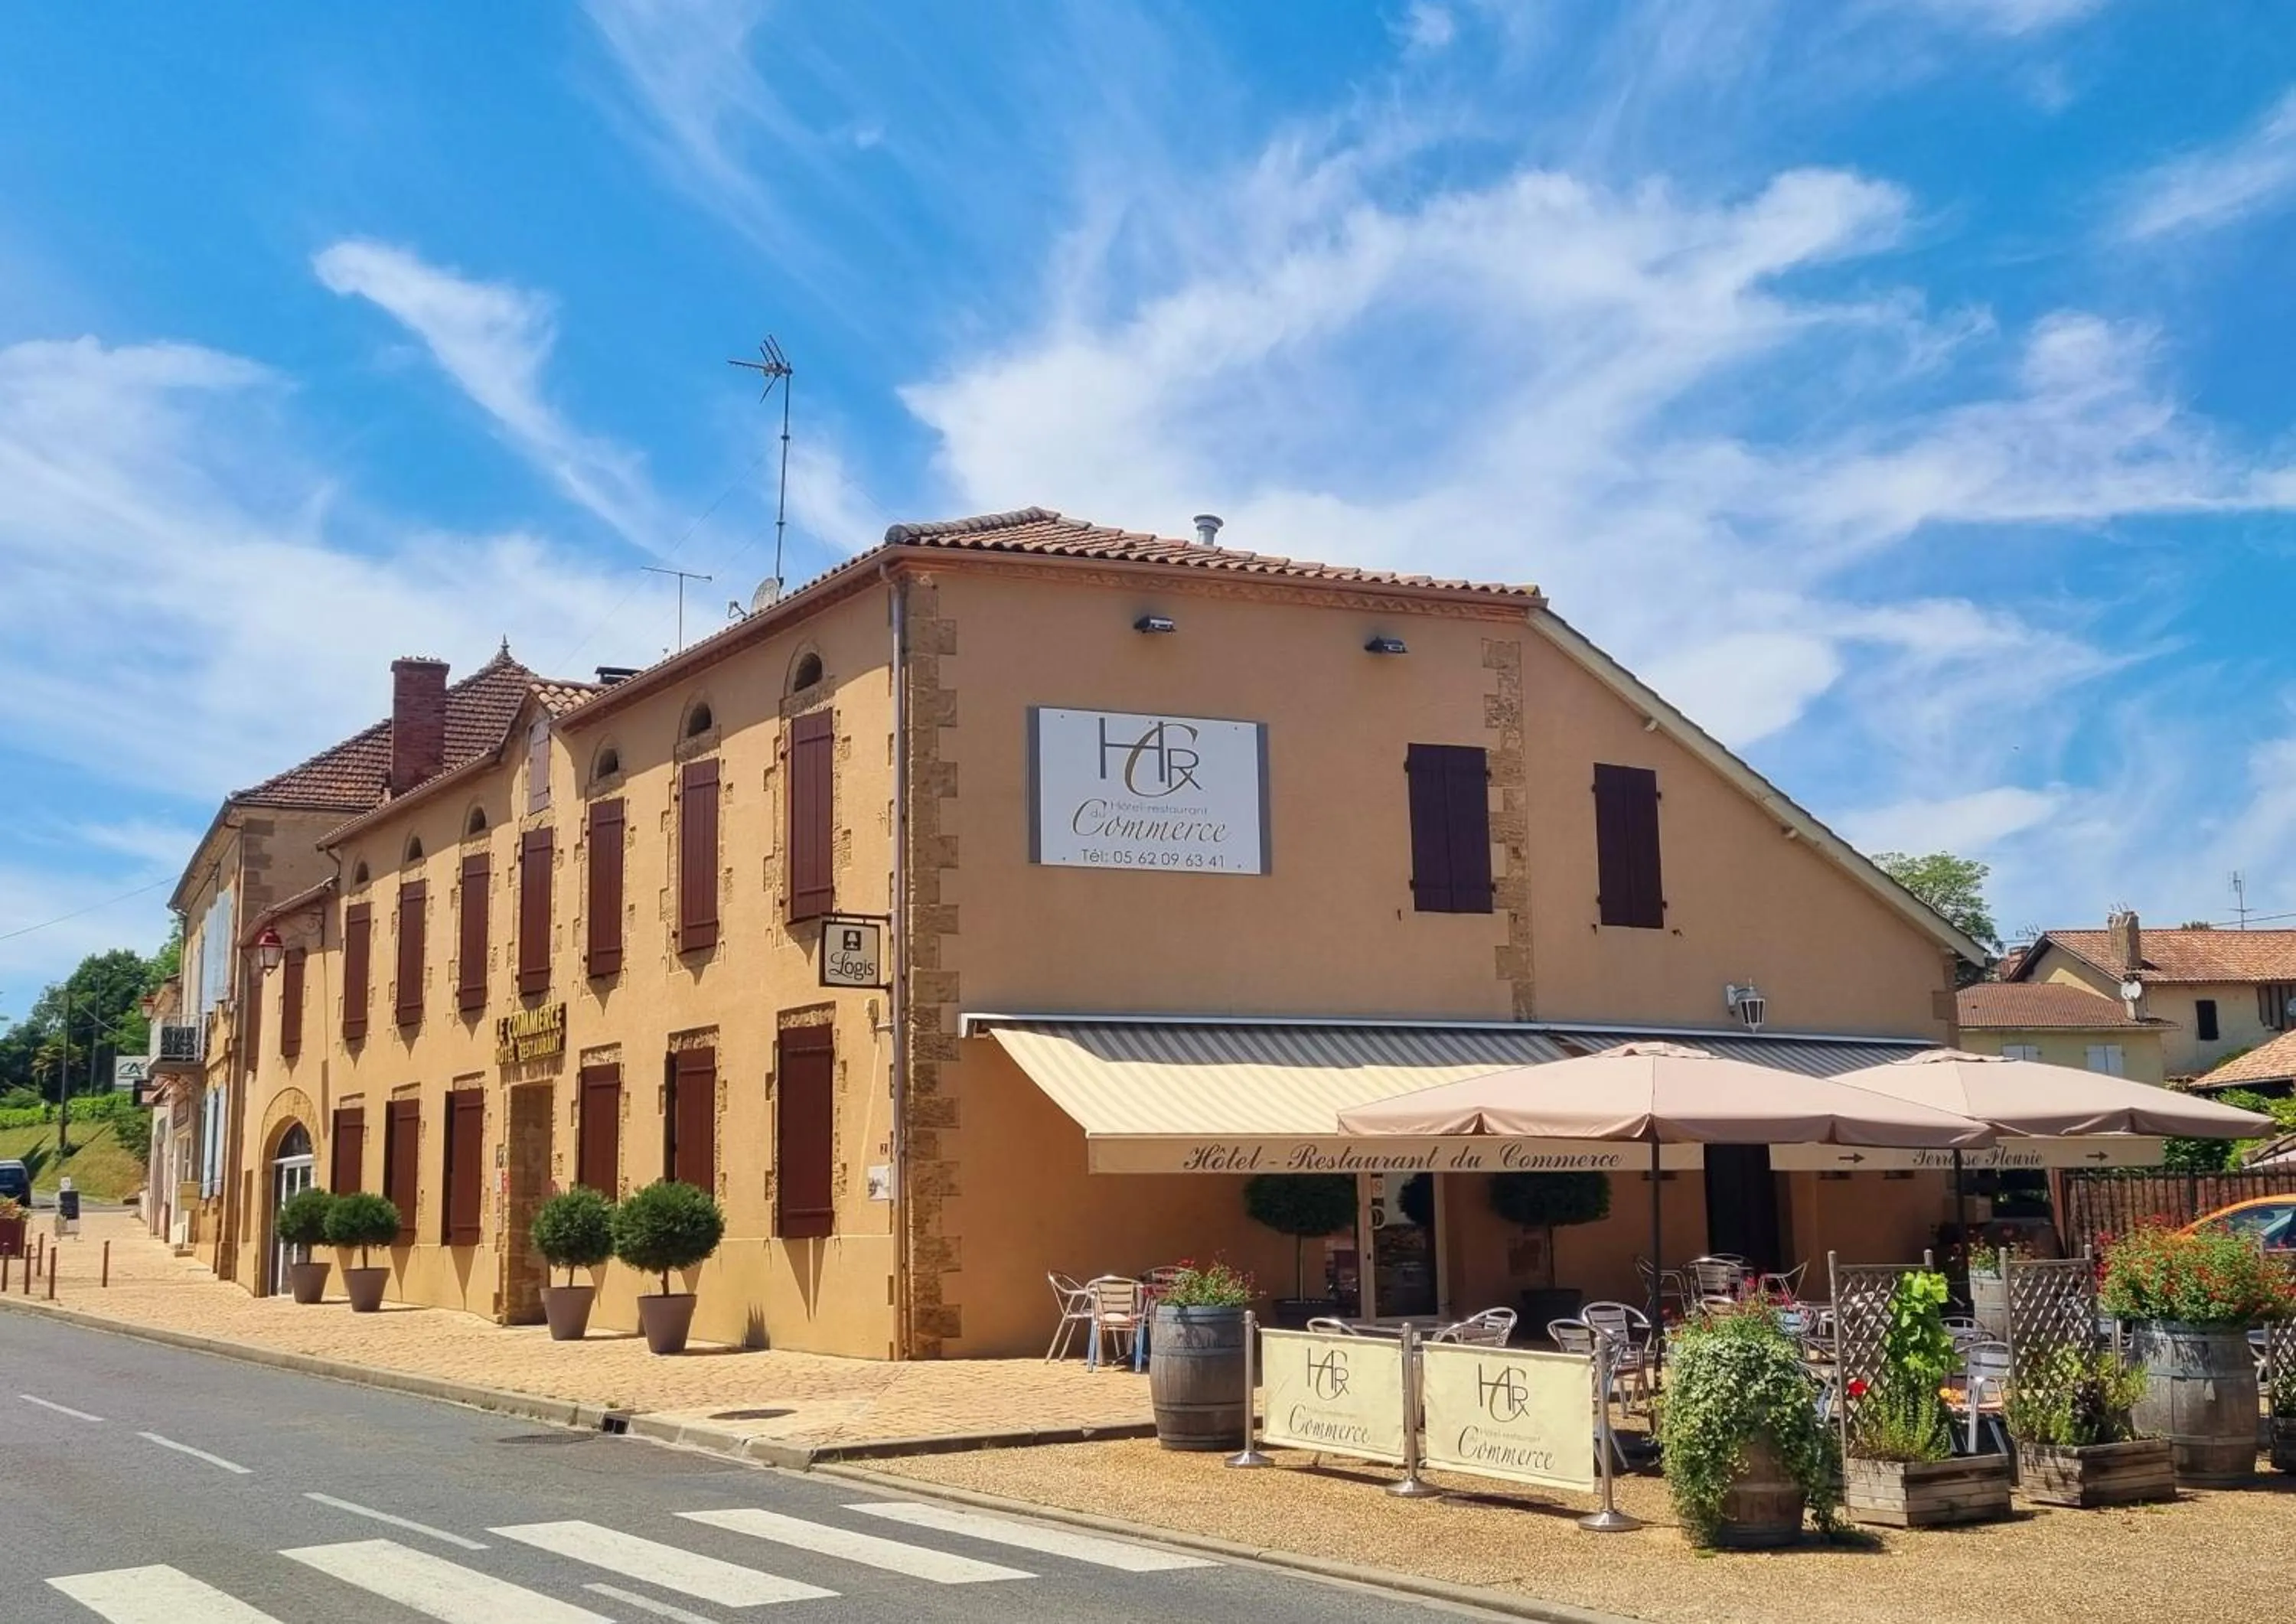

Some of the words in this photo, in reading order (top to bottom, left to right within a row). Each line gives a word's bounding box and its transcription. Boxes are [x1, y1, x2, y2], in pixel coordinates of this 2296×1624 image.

[1072, 798, 1229, 843] Commerce
[1081, 849, 1108, 863] Tél:
[1114, 850, 1132, 864] 05
[1138, 852, 1156, 865] 62
[1161, 852, 1179, 866] 09
[1186, 853, 1204, 867] 63
[1208, 855, 1225, 869] 41
[829, 951, 876, 980] Logis
[507, 1003, 565, 1044] COMMERCE
[1183, 1143, 1264, 1170] Hôtel
[1287, 1143, 1440, 1170] Restaurant
[1450, 1145, 1486, 1169] du
[1498, 1143, 1623, 1169] Commerce
[1985, 1144, 2045, 1166] Fleurie
[1289, 1403, 1371, 1444] Commerce
[1458, 1424, 1555, 1470] Commerce
